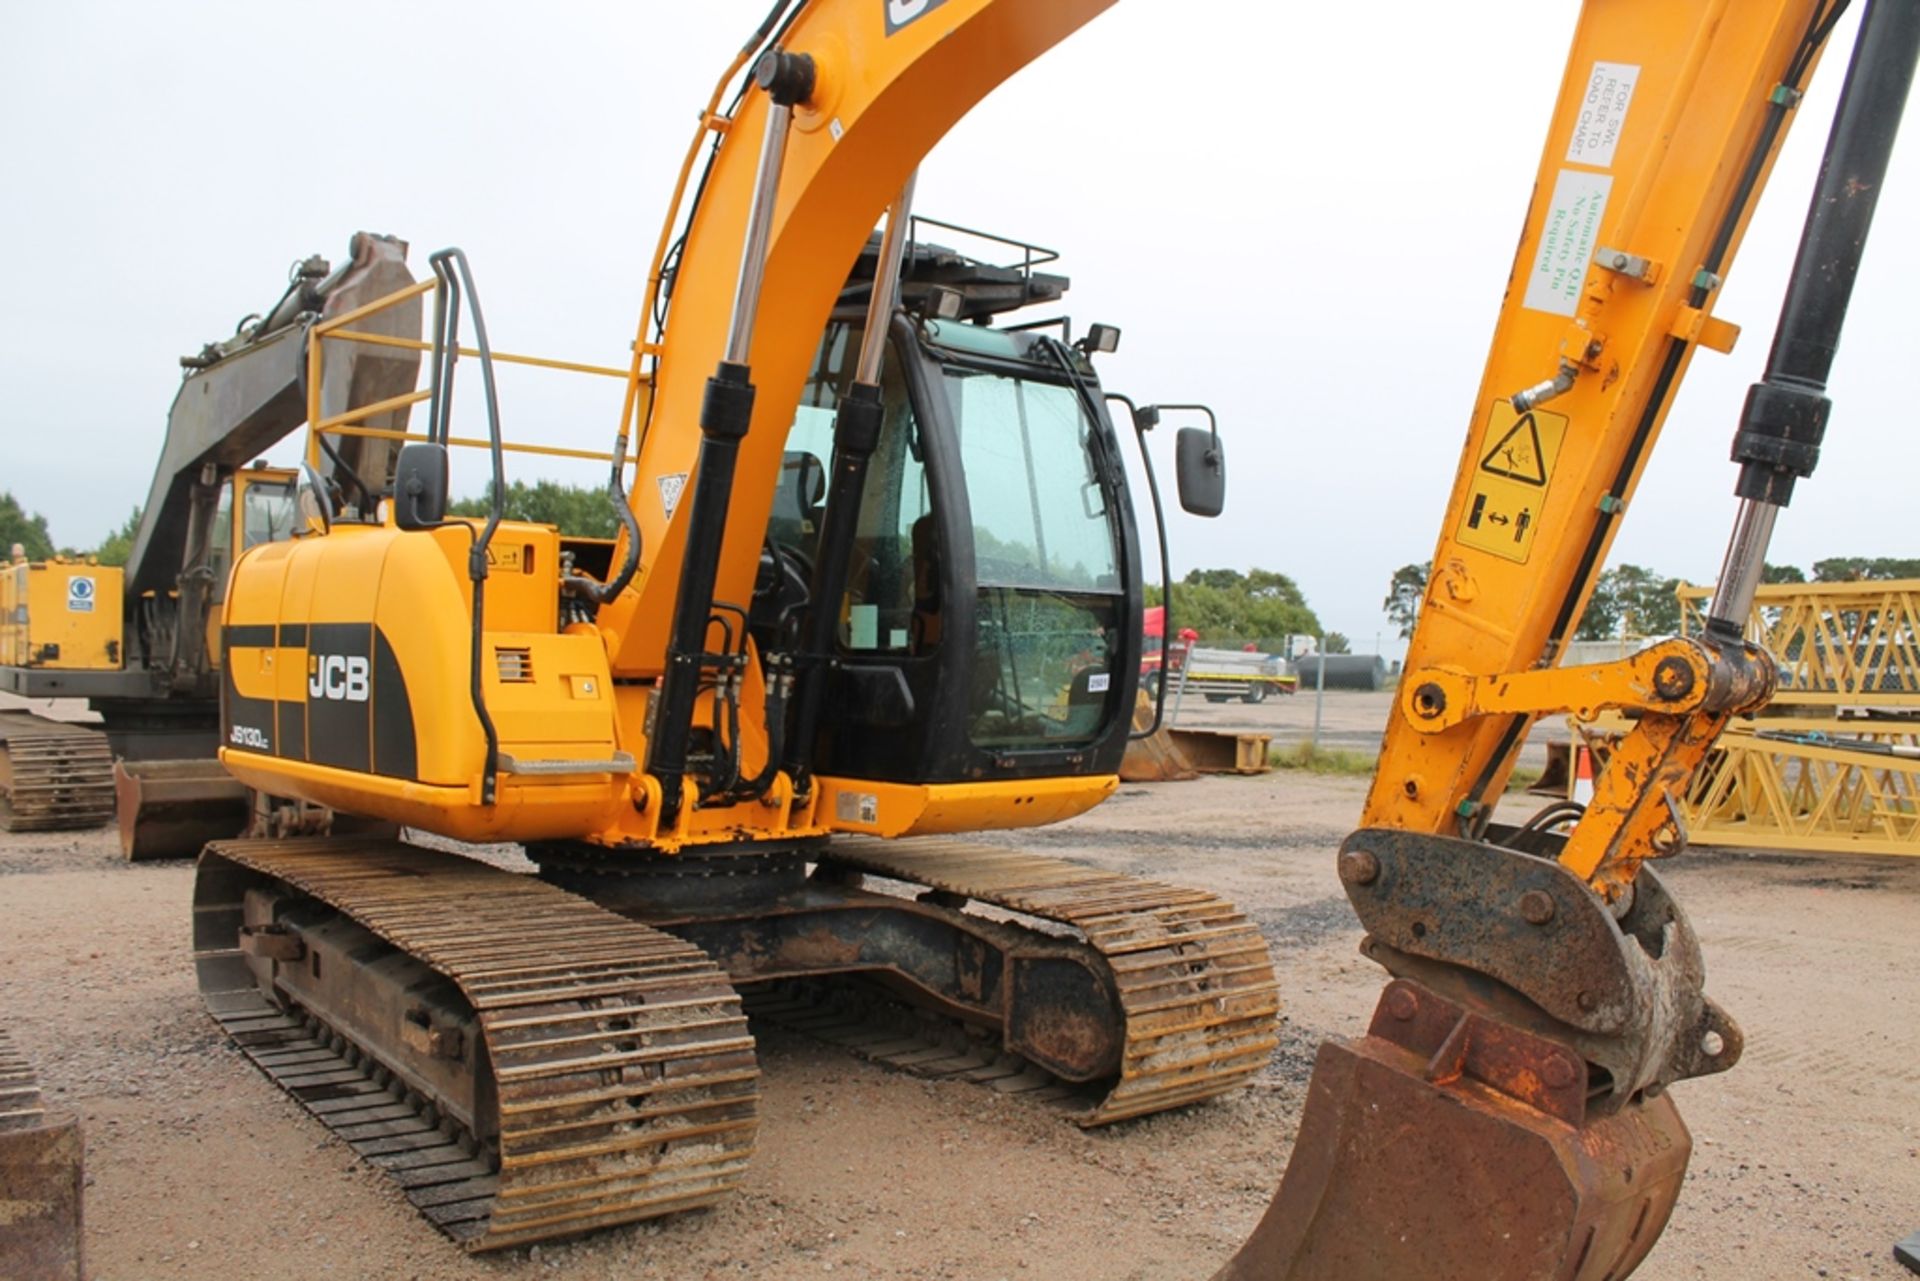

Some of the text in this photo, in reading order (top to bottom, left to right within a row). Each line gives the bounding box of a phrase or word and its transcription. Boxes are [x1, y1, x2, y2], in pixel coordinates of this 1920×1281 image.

[1587, 67, 1606, 104] LOAD
[1587, 78, 1617, 149] REFER TO
[1602, 83, 1631, 146] FOR SWL
[1540, 208, 1567, 273] Required
[1551, 196, 1587, 290] No Safety Pin
[1574, 190, 1603, 264] Automatic
[309, 655, 369, 702] JCB
